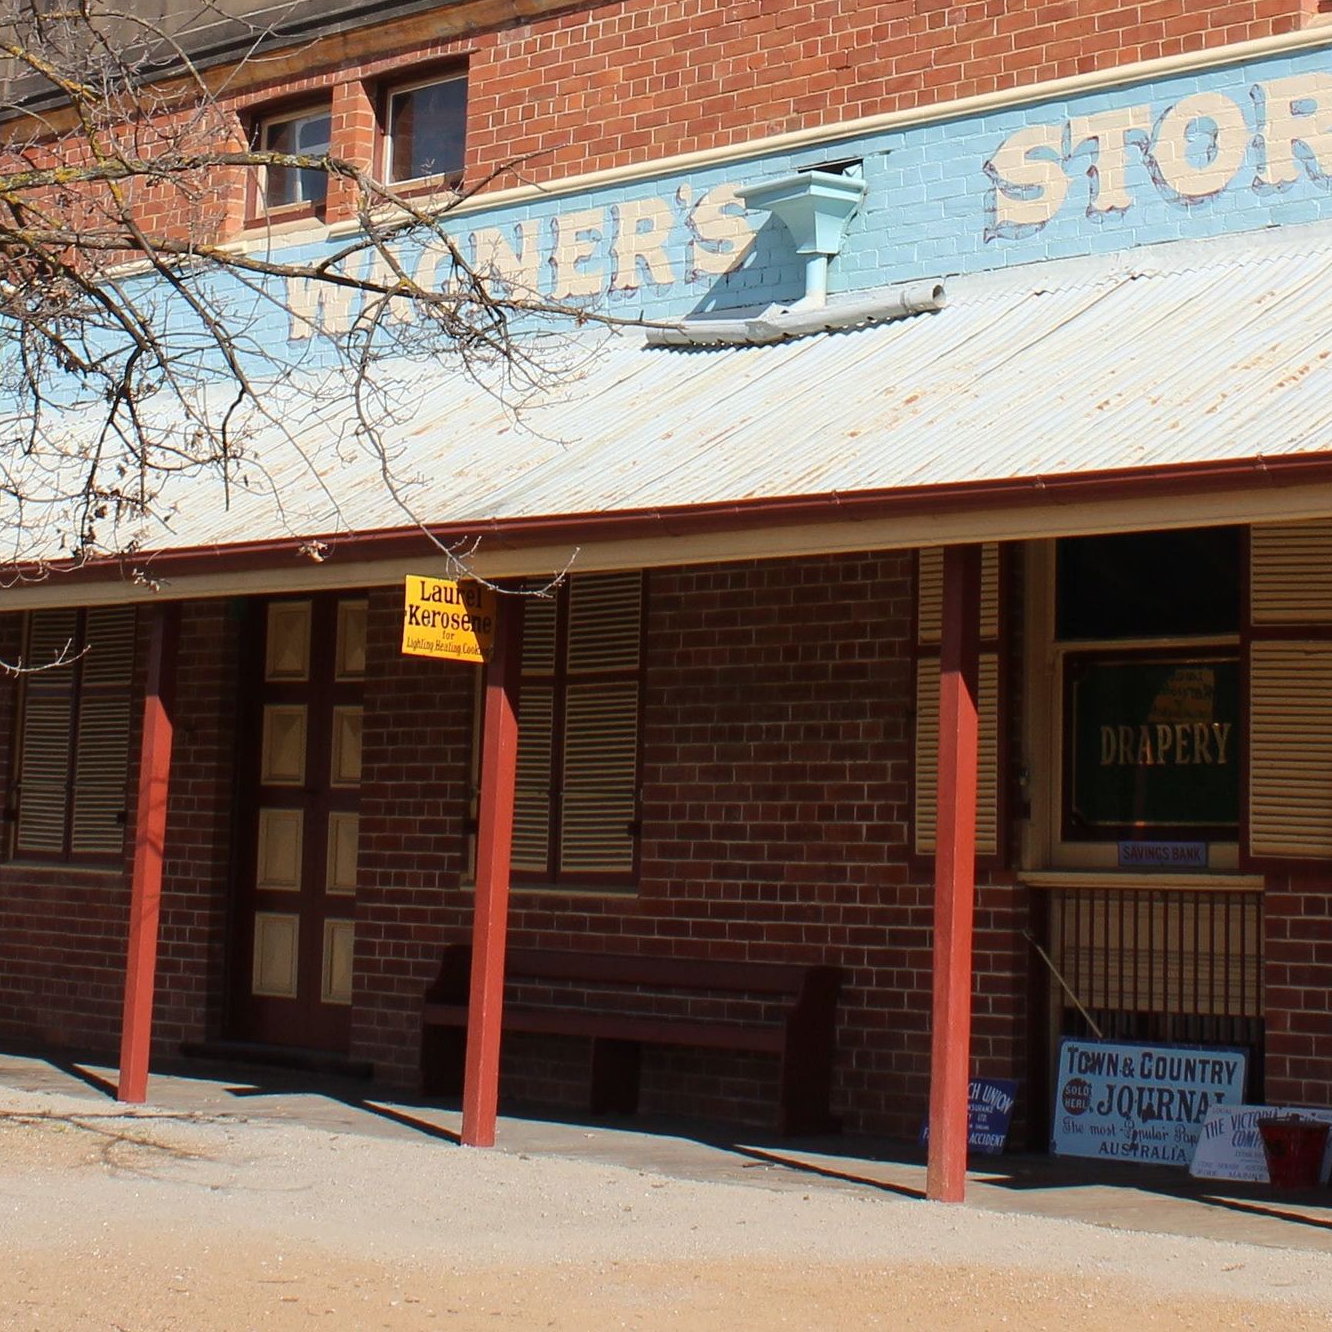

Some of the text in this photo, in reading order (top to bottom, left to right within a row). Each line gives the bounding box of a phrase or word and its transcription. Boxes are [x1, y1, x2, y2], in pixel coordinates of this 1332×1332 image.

[420, 580, 482, 608] Laurel
[408, 603, 491, 634] Kerosene
[442, 630, 455, 640] for
[1099, 721, 1231, 766] DRAPERY
[1123, 845, 1202, 862] SAVINGS BANK
[1068, 1047, 1239, 1086] TOWN & COUNTRY
[982, 1084, 1014, 1115] UNION
[1065, 1084, 1089, 1096] SOLD
[1060, 1117, 1085, 1136] The
[1089, 1124, 1116, 1137] most
[1205, 1117, 1224, 1139] THE
[970, 1132, 1005, 1147] ACCIDENT
